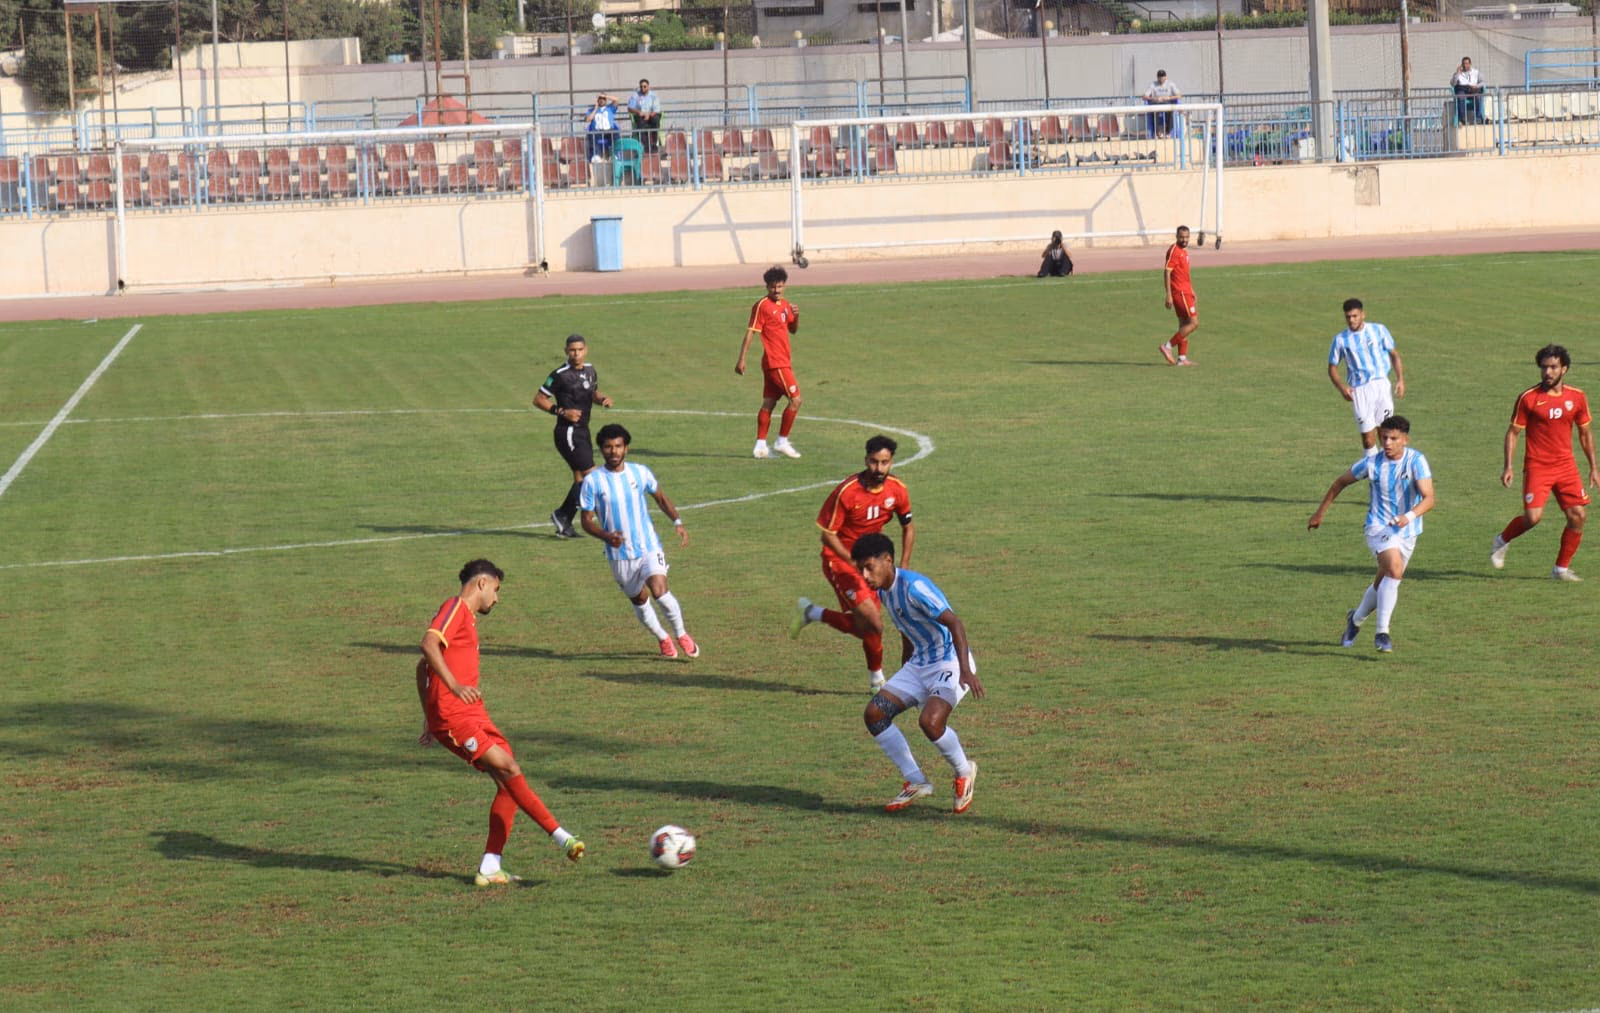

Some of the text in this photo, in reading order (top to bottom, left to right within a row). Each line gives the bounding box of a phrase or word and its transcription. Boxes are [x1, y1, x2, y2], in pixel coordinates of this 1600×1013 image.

[1549, 407, 1563, 420] 19
[866, 505, 880, 520] 11
[938, 670, 953, 682] 17
